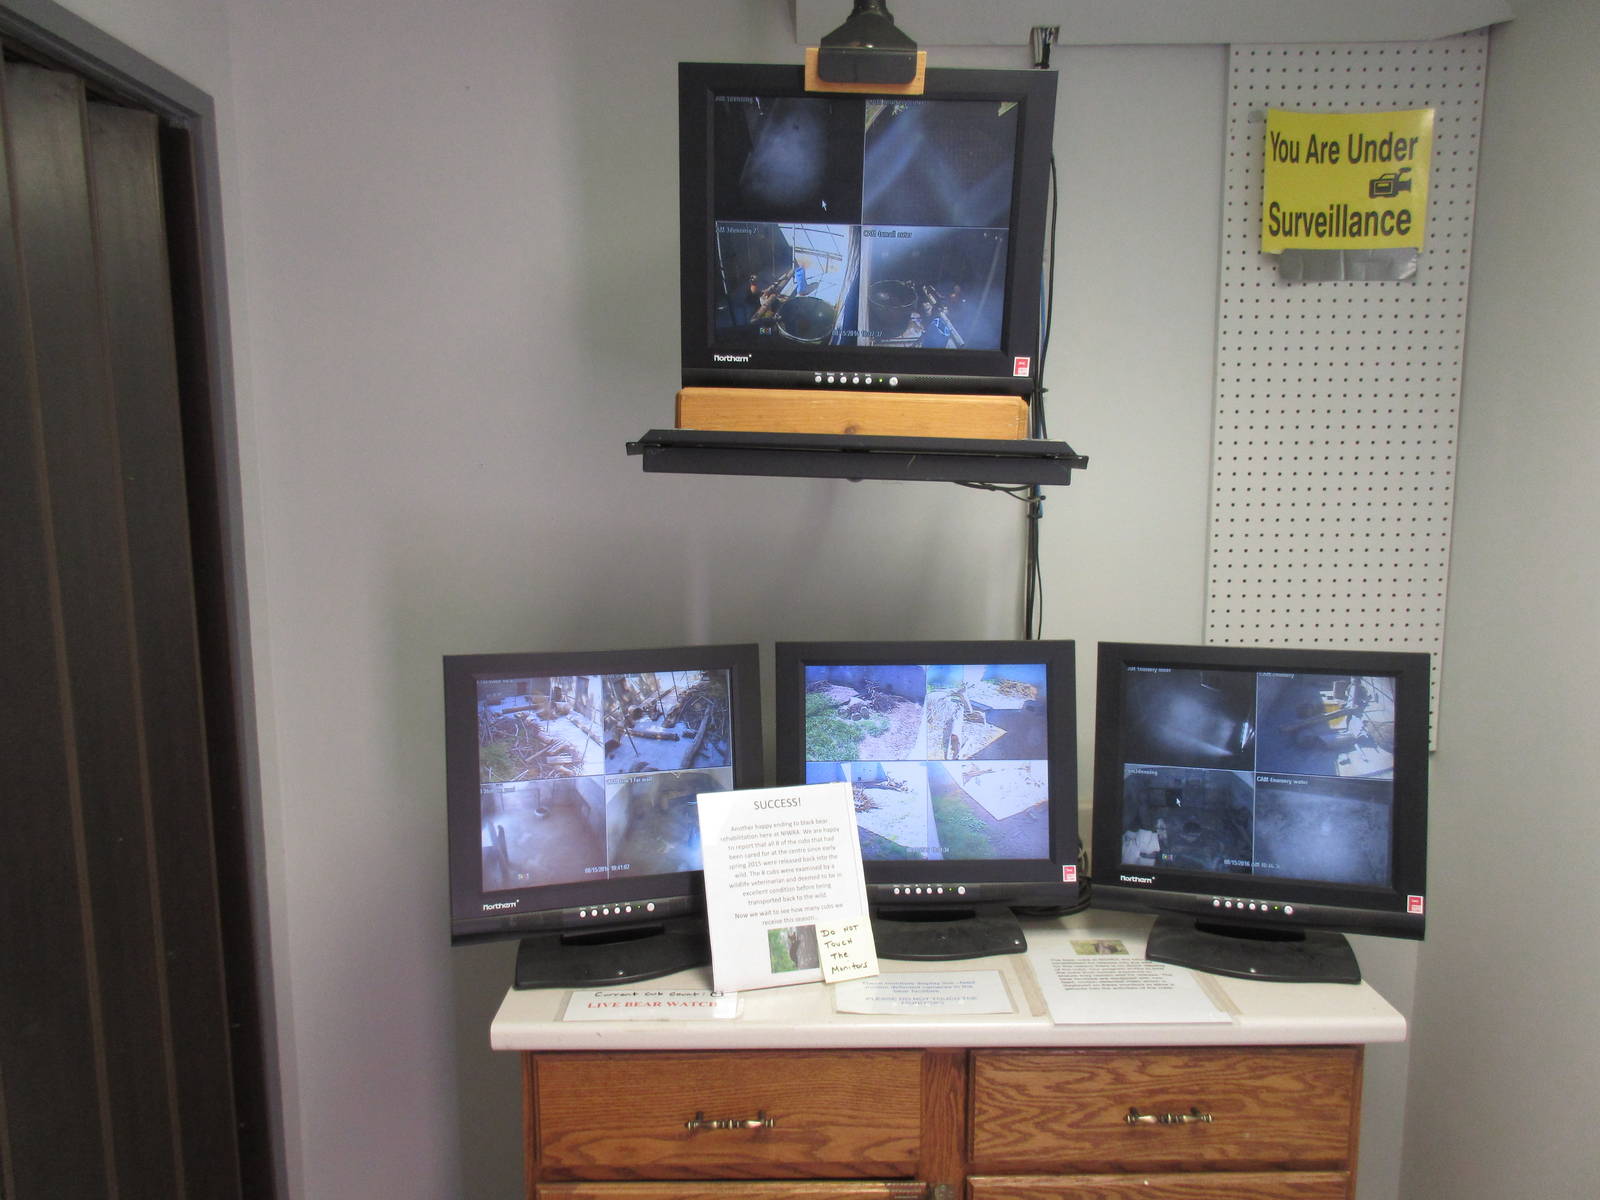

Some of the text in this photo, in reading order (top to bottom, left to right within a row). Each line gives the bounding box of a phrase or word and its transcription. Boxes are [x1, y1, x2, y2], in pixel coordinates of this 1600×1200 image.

[1270, 130, 1418, 165] You Are Under
[1268, 201, 1412, 238] Surveillance
[713, 354, 749, 363] Northern
[753, 797, 801, 810] SUCCESS!
[1120, 874, 1153, 884] Northern
[482, 902, 516, 912] Northern
[587, 1000, 621, 1009] LIVE
[624, 1000, 662, 1008] BEAR
